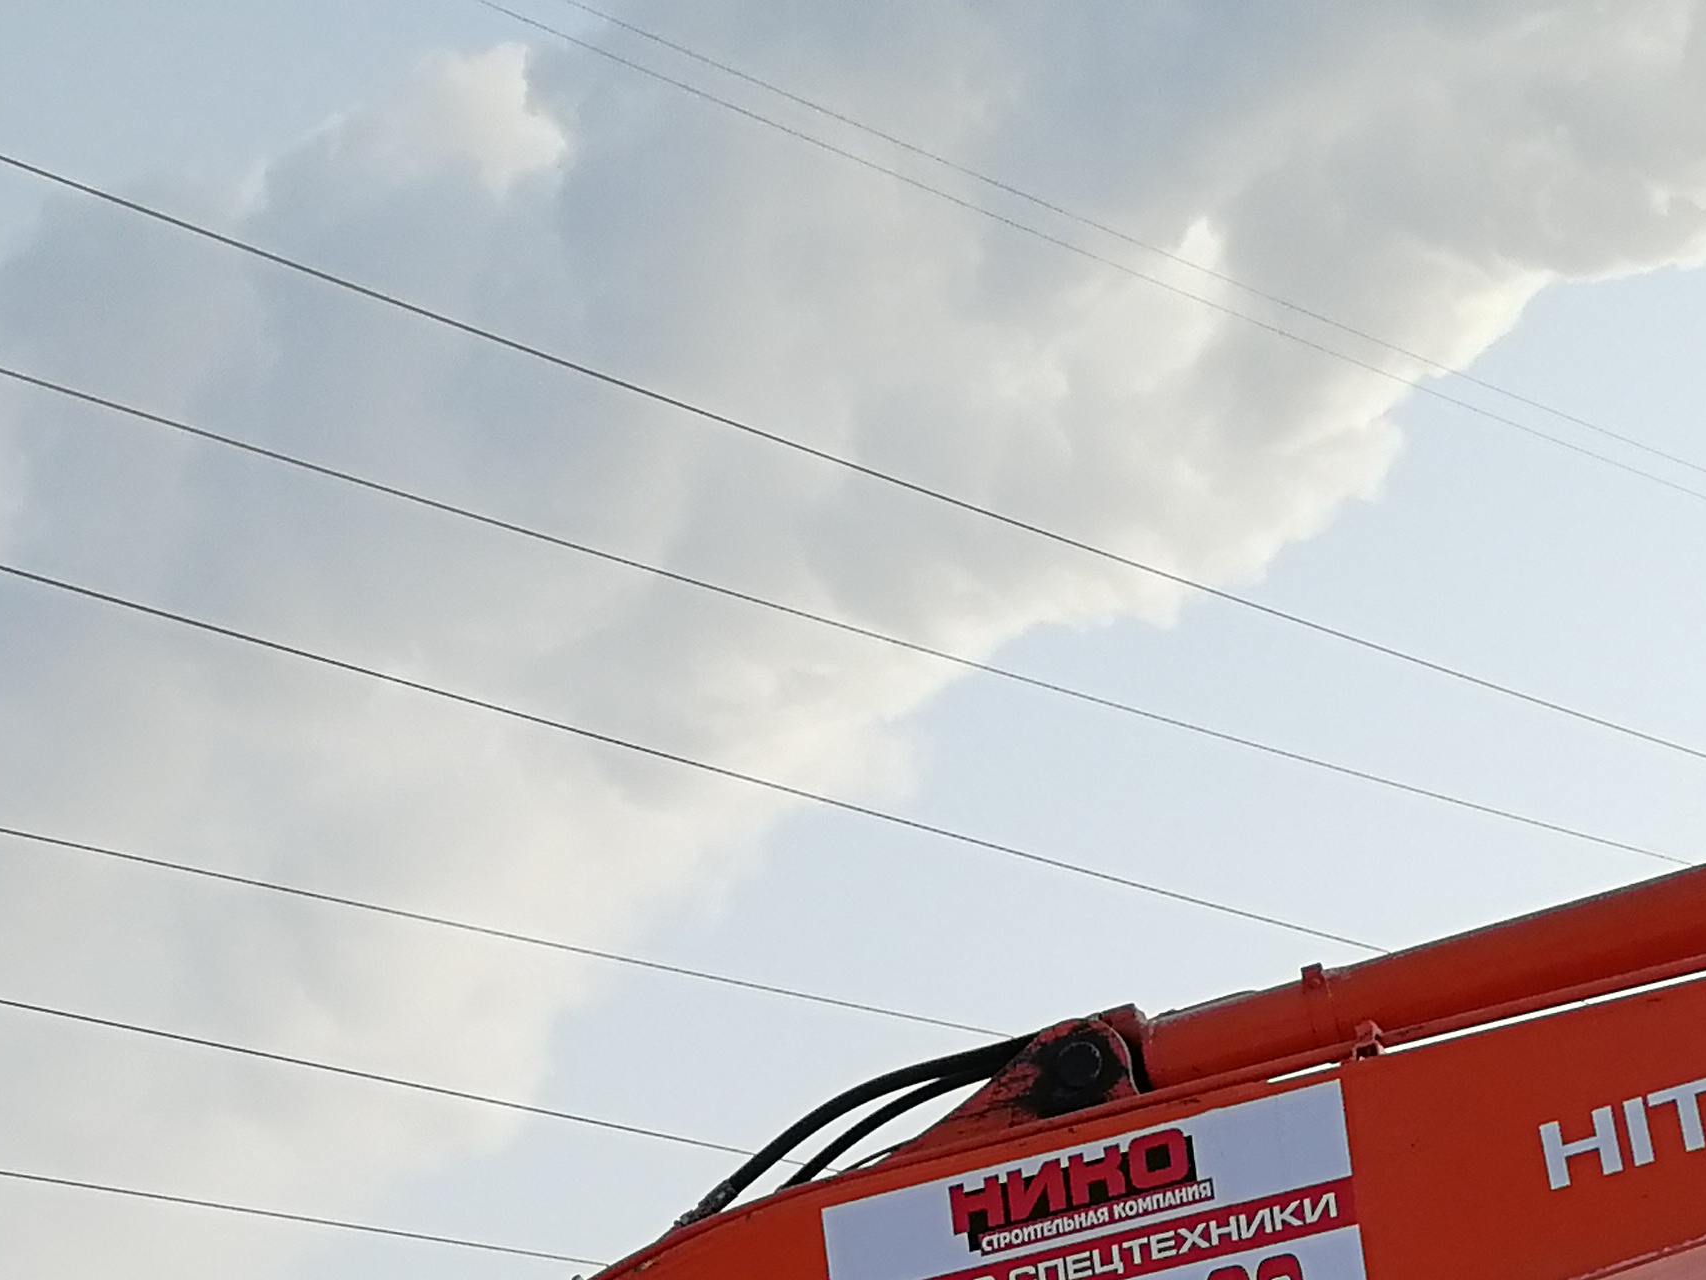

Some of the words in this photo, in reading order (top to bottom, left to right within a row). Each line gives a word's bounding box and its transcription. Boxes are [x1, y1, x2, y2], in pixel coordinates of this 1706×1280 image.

[948, 1128, 1192, 1238] НИКО
[980, 1207, 1110, 1252] СТРОИТЕЛЬНАЯ
[1114, 1181, 1213, 1218] КОМПАНИЯ
